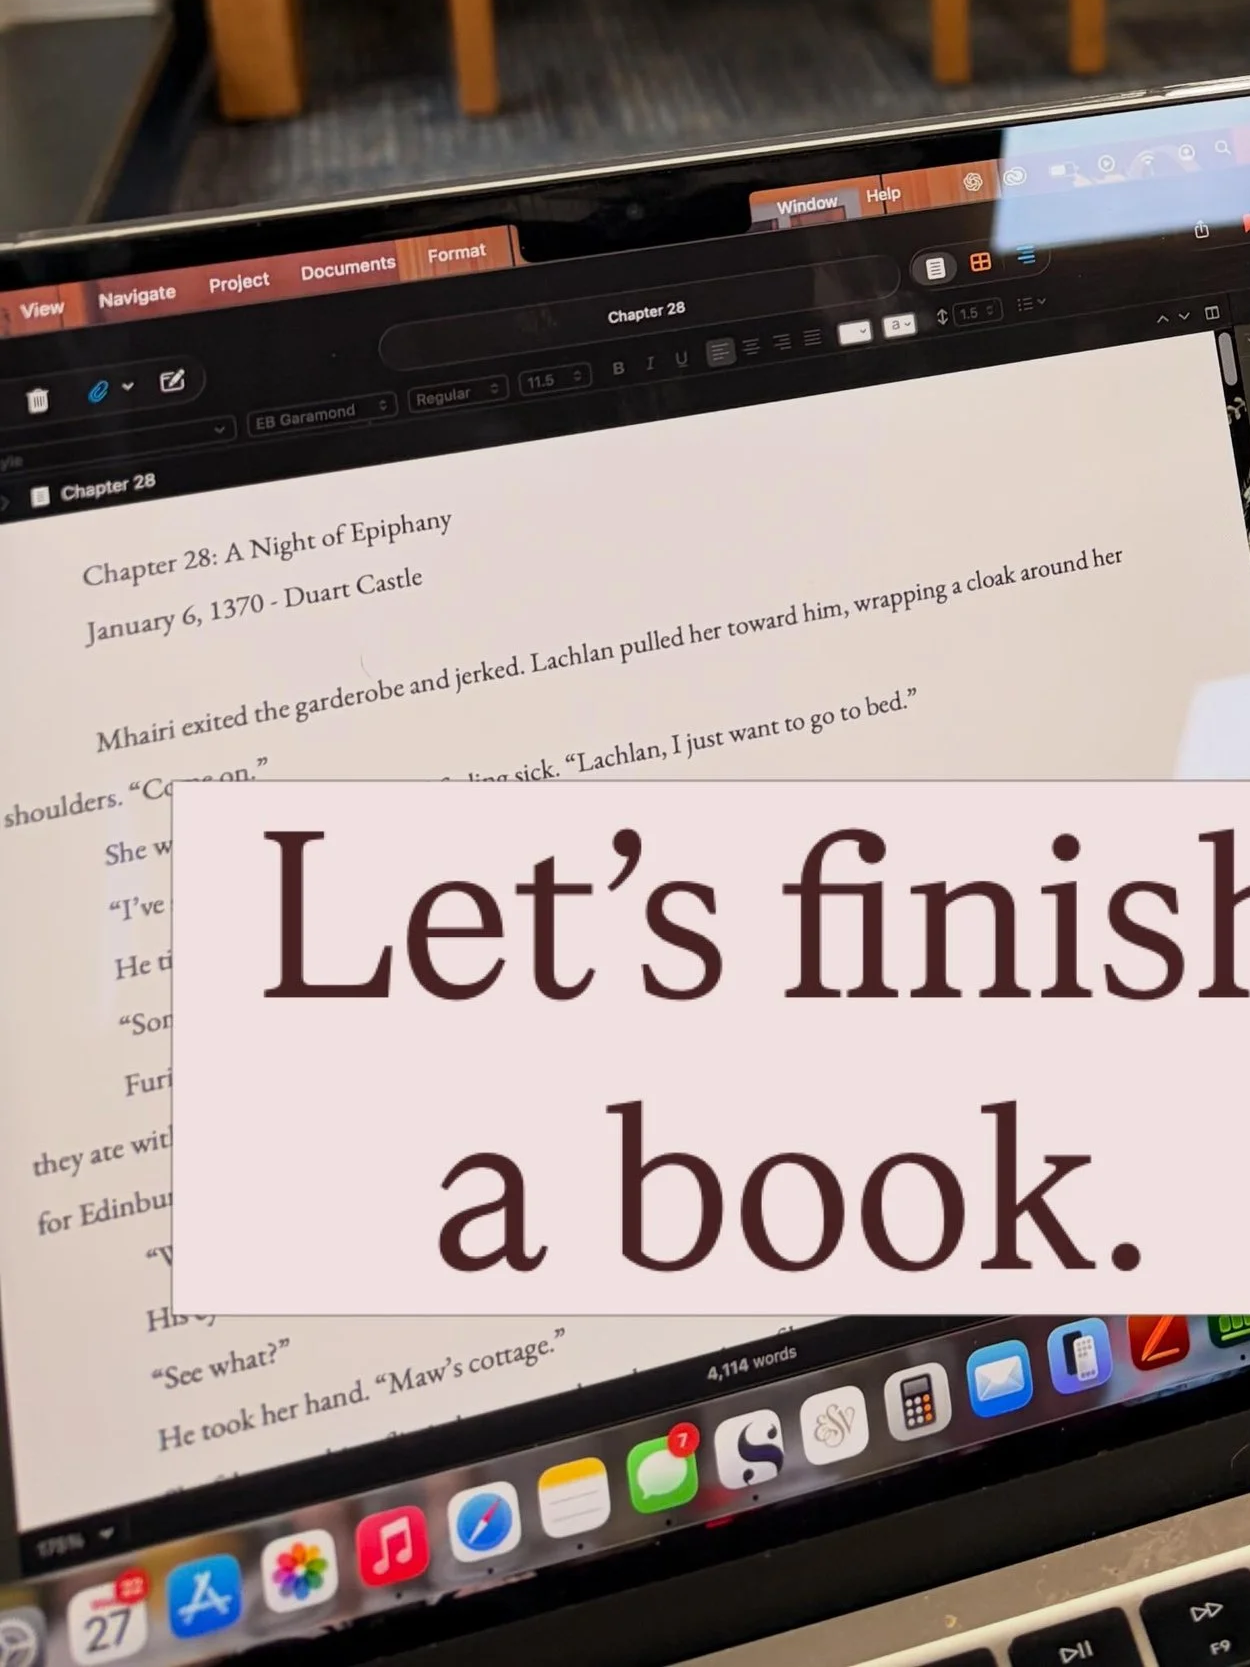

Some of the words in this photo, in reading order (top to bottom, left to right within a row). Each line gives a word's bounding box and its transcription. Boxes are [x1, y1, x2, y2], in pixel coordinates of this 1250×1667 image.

[776, 196, 838, 215] Window
[866, 187, 901, 203] Help
[20, 300, 65, 319] View
[98, 284, 177, 310] Navigate
[209, 271, 271, 294] Project
[301, 256, 397, 281] Documents
[427, 243, 487, 264] Format
[607, 305, 664, 324] Chapter
[666, 301, 687, 316] 28
[416, 387, 472, 407] Regular
[527, 373, 555, 389] 11.5
[255, 415, 276, 431] EB
[280, 403, 356, 427] Garamond
[60, 478, 130, 502] Chapter
[133, 472, 157, 489] 28
[83, 557, 178, 587] Chapter
[184, 547, 218, 570] 28:
[224, 541, 245, 564] A
[249, 531, 317, 562] Night
[321, 522, 347, 548] of
[350, 513, 453, 548] Epiphany
[84, 613, 176, 649] January
[182, 604, 203, 627] 6,
[210, 593, 265, 622] 1370
[283, 583, 351, 608] Duart
[356, 566, 424, 596] Castle
[96, 719, 176, 754] Mhairi
[181, 704, 249, 738] exited
[254, 700, 292, 724] the
[294, 679, 406, 724] garderobe
[409, 668, 451, 696] and
[454, 655, 526, 695] jerked.
[530, 642, 615, 674] Lachlan
[619, 625, 685, 664] pulled
[688, 623, 722, 645] her
[726, 605, 799, 639] toward
[801, 598, 851, 623] him,
[853, 579, 949, 612] wrapping
[951, 579, 963, 596] a
[965, 564, 1017, 593] cloak
[1019, 550, 1090, 583] around
[1092, 546, 1124, 570] her
[514, 758, 561, 782] sick.
[671, 733, 682, 755] I
[686, 729, 725, 760] just
[728, 719, 780, 743] want
[785, 716, 805, 733] to
[810, 710, 835, 735] go
[840, 704, 862, 722] to
[865, 686, 918, 717] bed.”
[3, 791, 124, 829] shoulders.
[104, 840, 148, 867] She
[114, 954, 152, 981] He
[32, 1152, 85, 1178] they
[89, 1141, 125, 1165] ate
[38, 1209, 73, 1236] for
[706, 1357, 749, 1382] 4,114
[752, 1345, 798, 1370] words
[157, 1424, 196, 1453] He
[201, 1407, 255, 1441] took
[261, 1401, 300, 1427] her
[304, 1379, 370, 1415] hand.
[84, 1607, 132, 1653] 27
[1209, 1638, 1232, 1656] F9
